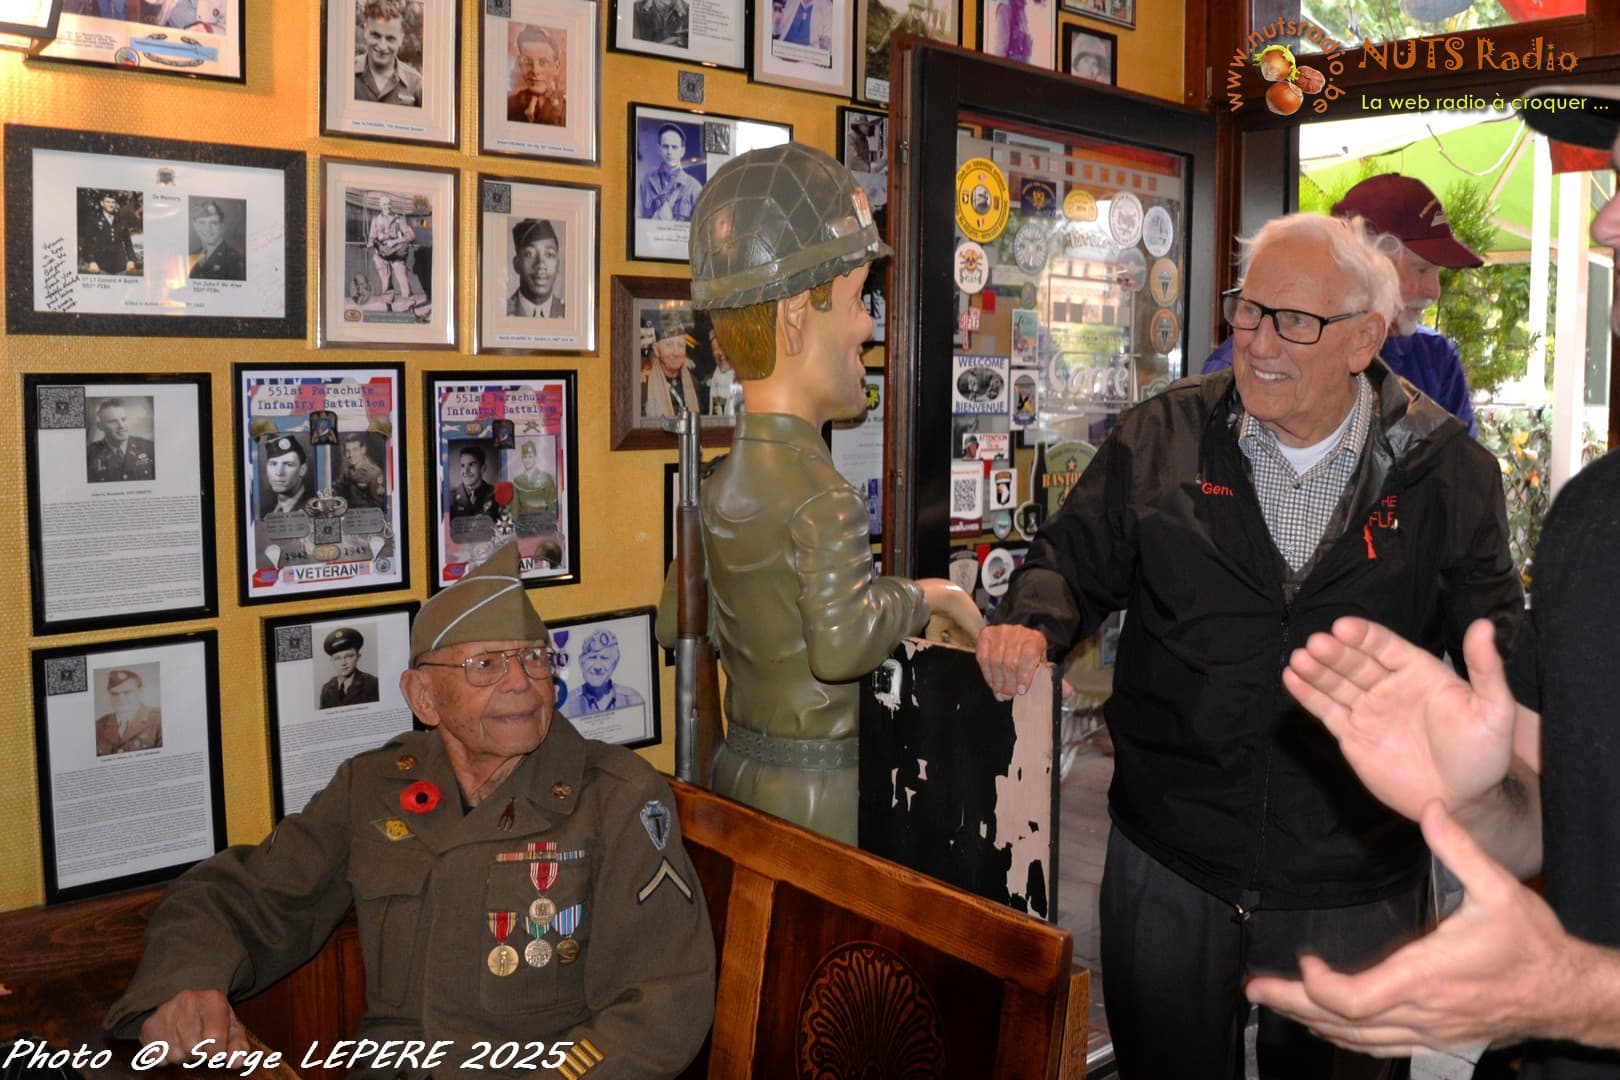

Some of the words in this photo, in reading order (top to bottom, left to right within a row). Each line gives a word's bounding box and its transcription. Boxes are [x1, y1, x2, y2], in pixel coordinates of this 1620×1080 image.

[958, 356, 1005, 369] WELCOME
[268, 386, 303, 396] 551st
[312, 386, 375, 396] Parachute
[258, 400, 314, 411] Infantry
[323, 399, 385, 409] Battalion
[456, 394, 487, 404] 551st
[447, 406, 496, 417] Infantry
[503, 405, 557, 415] Battalion
[955, 401, 1005, 413] BIENVENUE
[1042, 471, 1082, 488] BASTO
[296, 564, 358, 579] VETERAN
